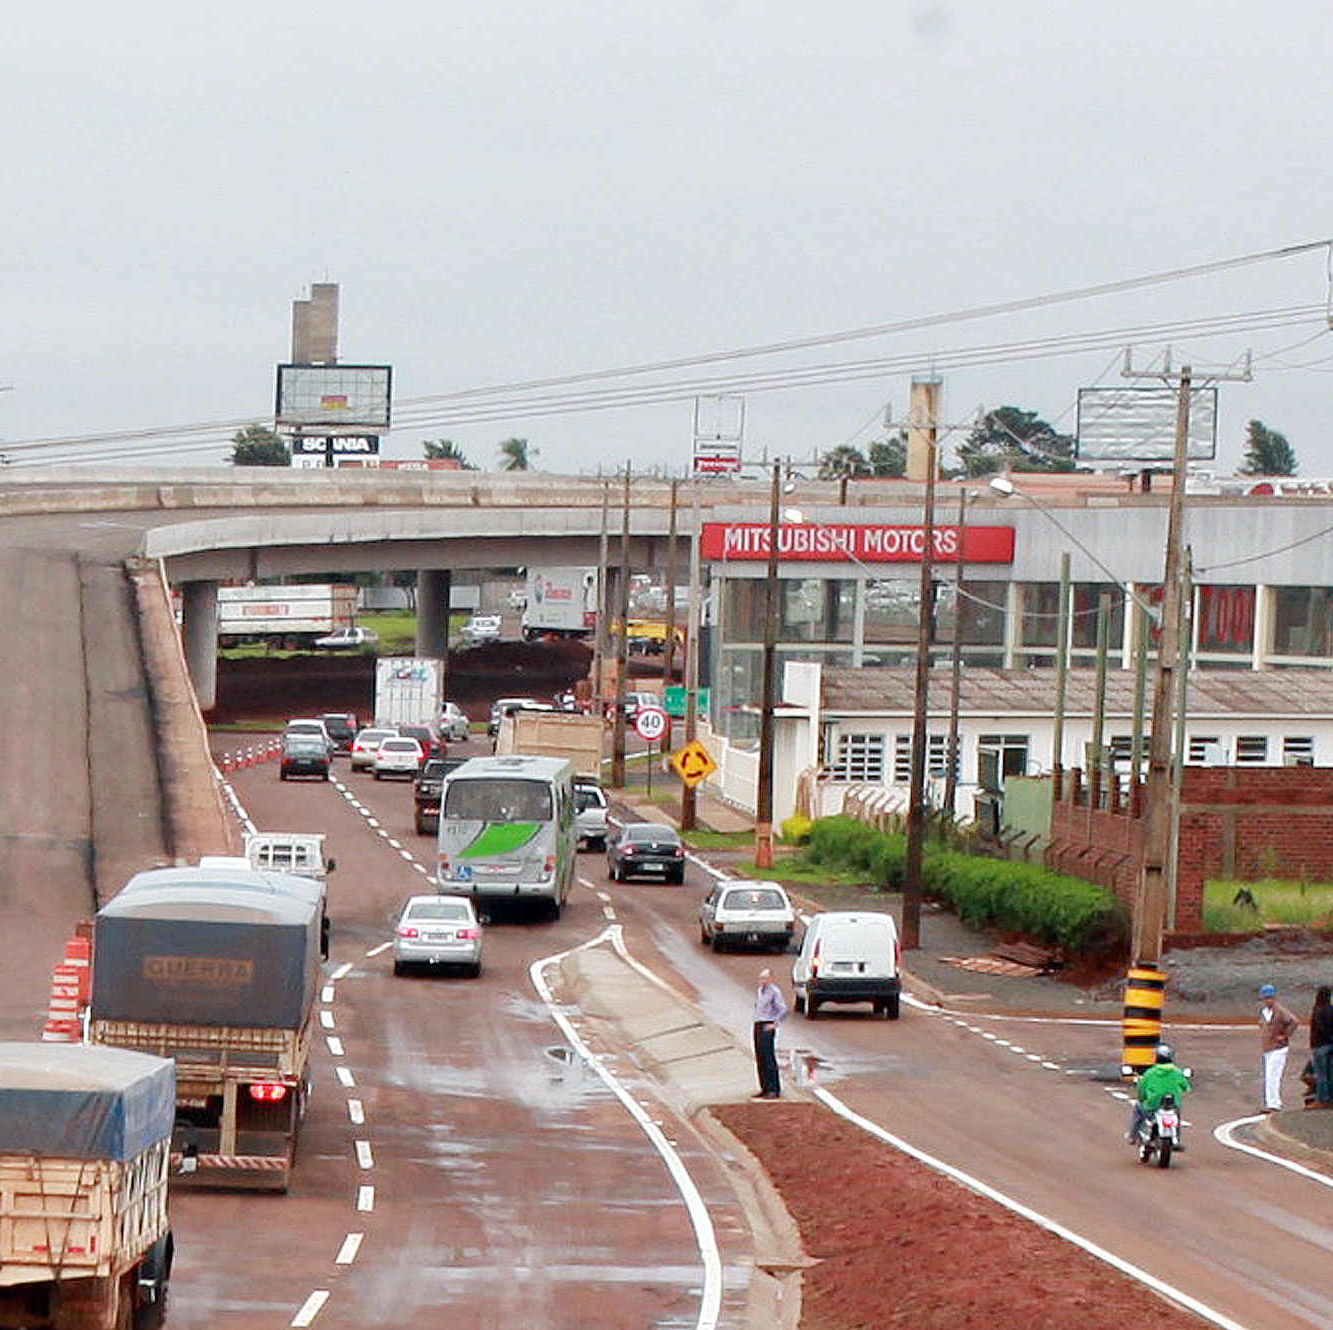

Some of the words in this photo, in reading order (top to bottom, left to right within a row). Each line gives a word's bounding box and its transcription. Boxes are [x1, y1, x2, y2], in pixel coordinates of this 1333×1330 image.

[724, 527, 855, 552] MITSUBISHI
[864, 529, 958, 553] MOTORS
[641, 714, 661, 728] 40
